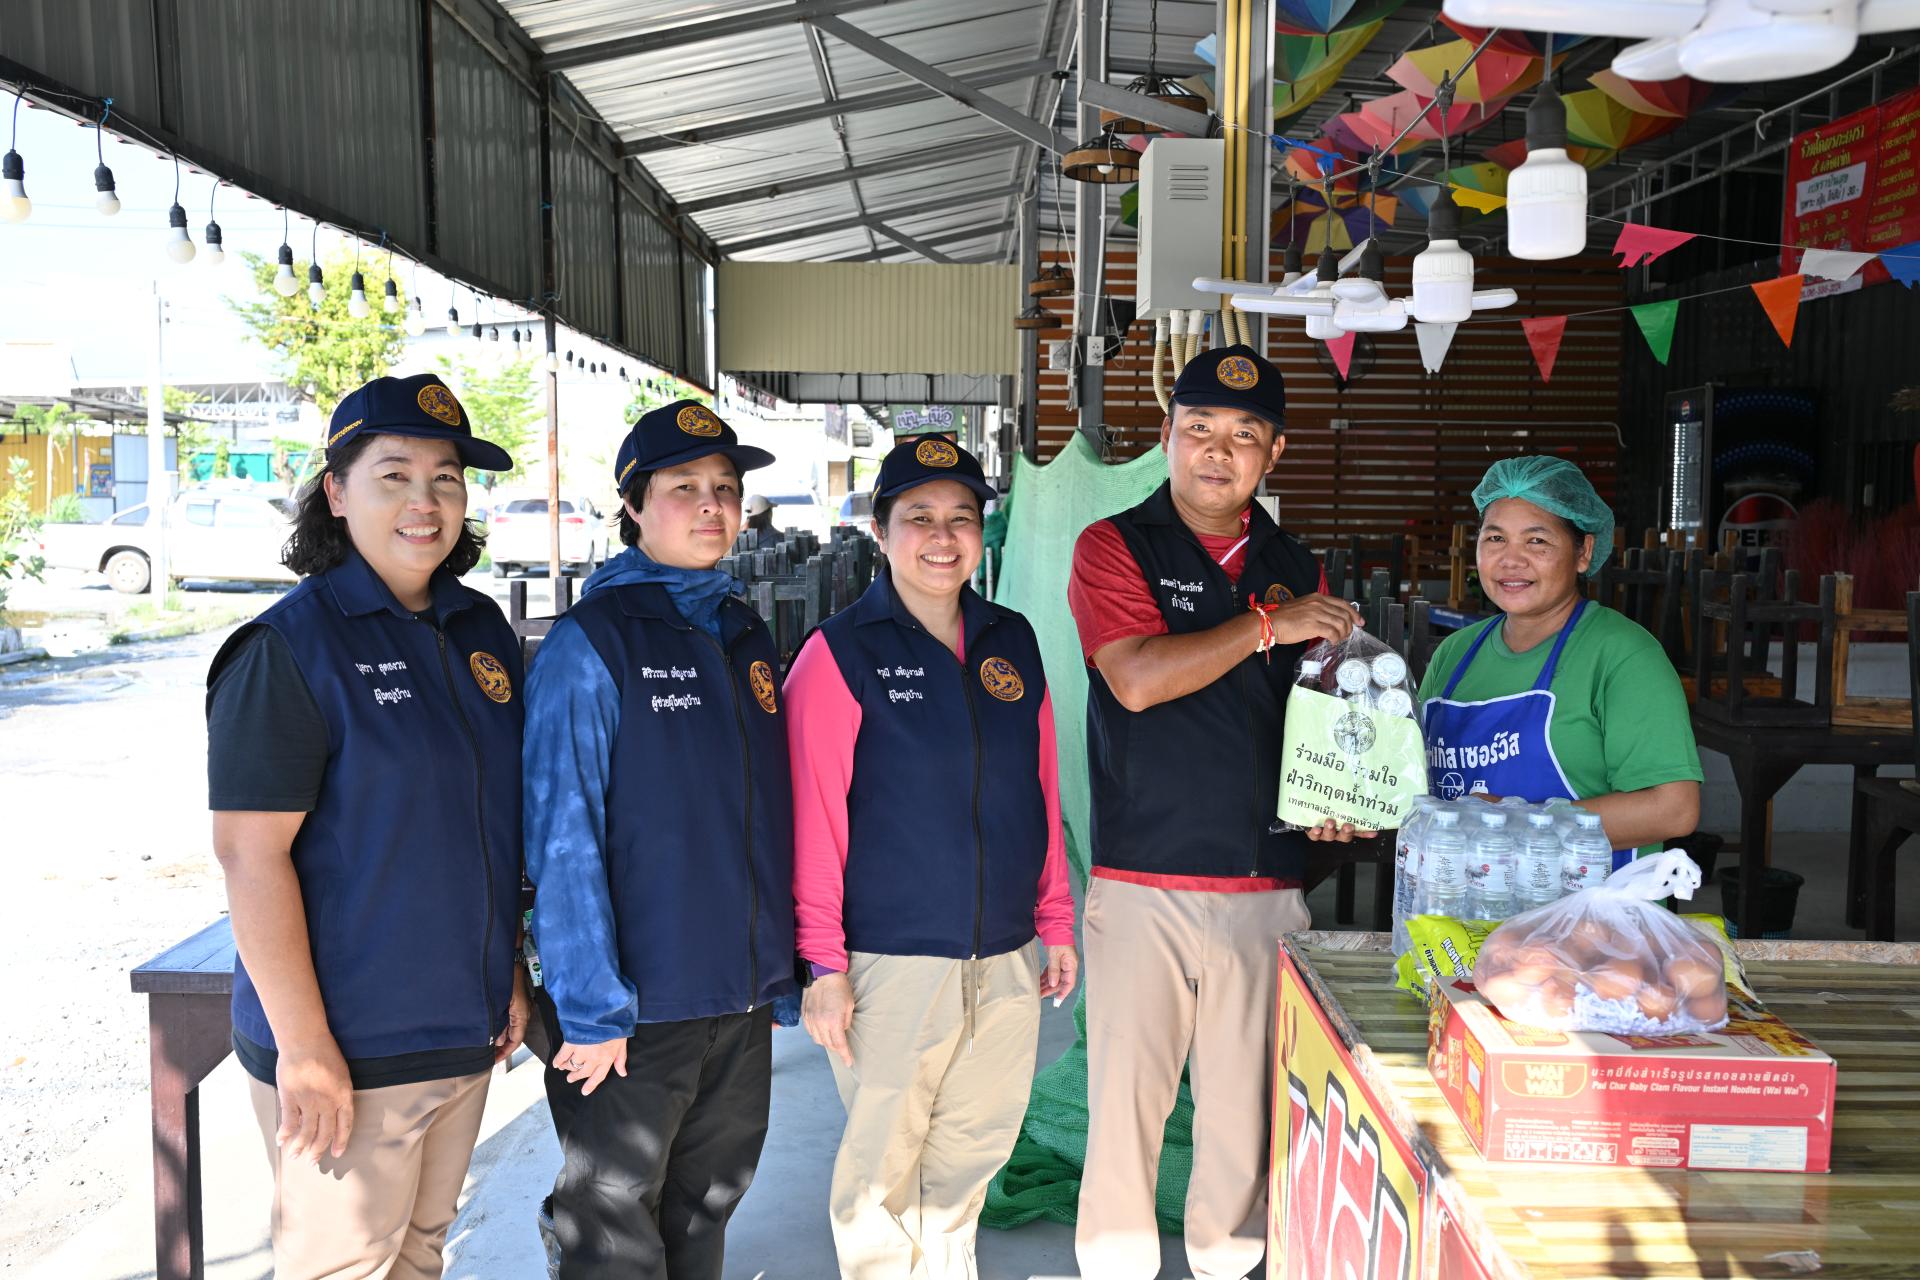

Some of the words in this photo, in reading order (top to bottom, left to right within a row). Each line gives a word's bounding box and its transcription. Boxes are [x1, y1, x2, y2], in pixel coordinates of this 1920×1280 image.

[1171, 593, 1195, 613] กำนัน
[1295, 743, 1345, 772] ร่วมมือ
[1286, 768, 1399, 817] ฝ่าวิกฤตน้ำท่วม
[1629, 1082, 1648, 1092] Baby
